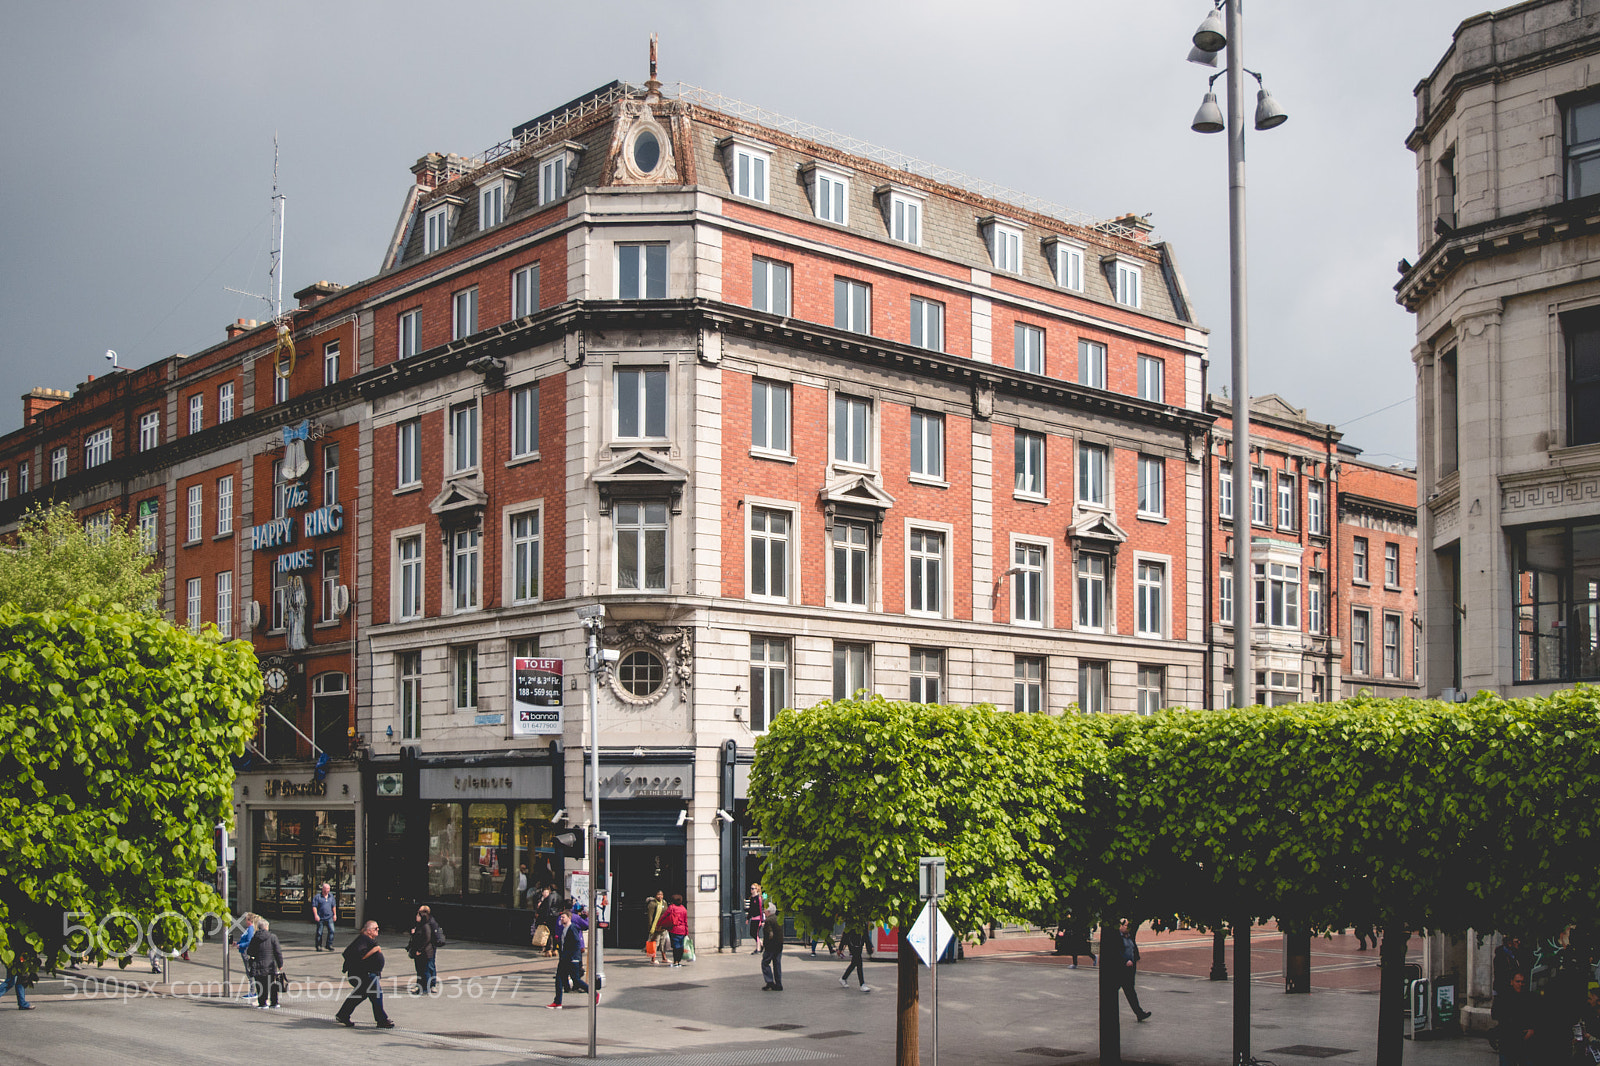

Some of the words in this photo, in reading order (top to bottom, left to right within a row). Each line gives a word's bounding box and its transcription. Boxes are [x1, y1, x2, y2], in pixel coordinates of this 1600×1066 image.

[285, 482, 308, 509] The
[252, 517, 294, 551] HAPPY
[304, 504, 343, 538] RING
[278, 549, 313, 573] HOUSE
[524, 660, 538, 669] TO
[540, 660, 556, 669] LET
[518, 688, 530, 696] 188
[454, 775, 513, 792] kylemore
